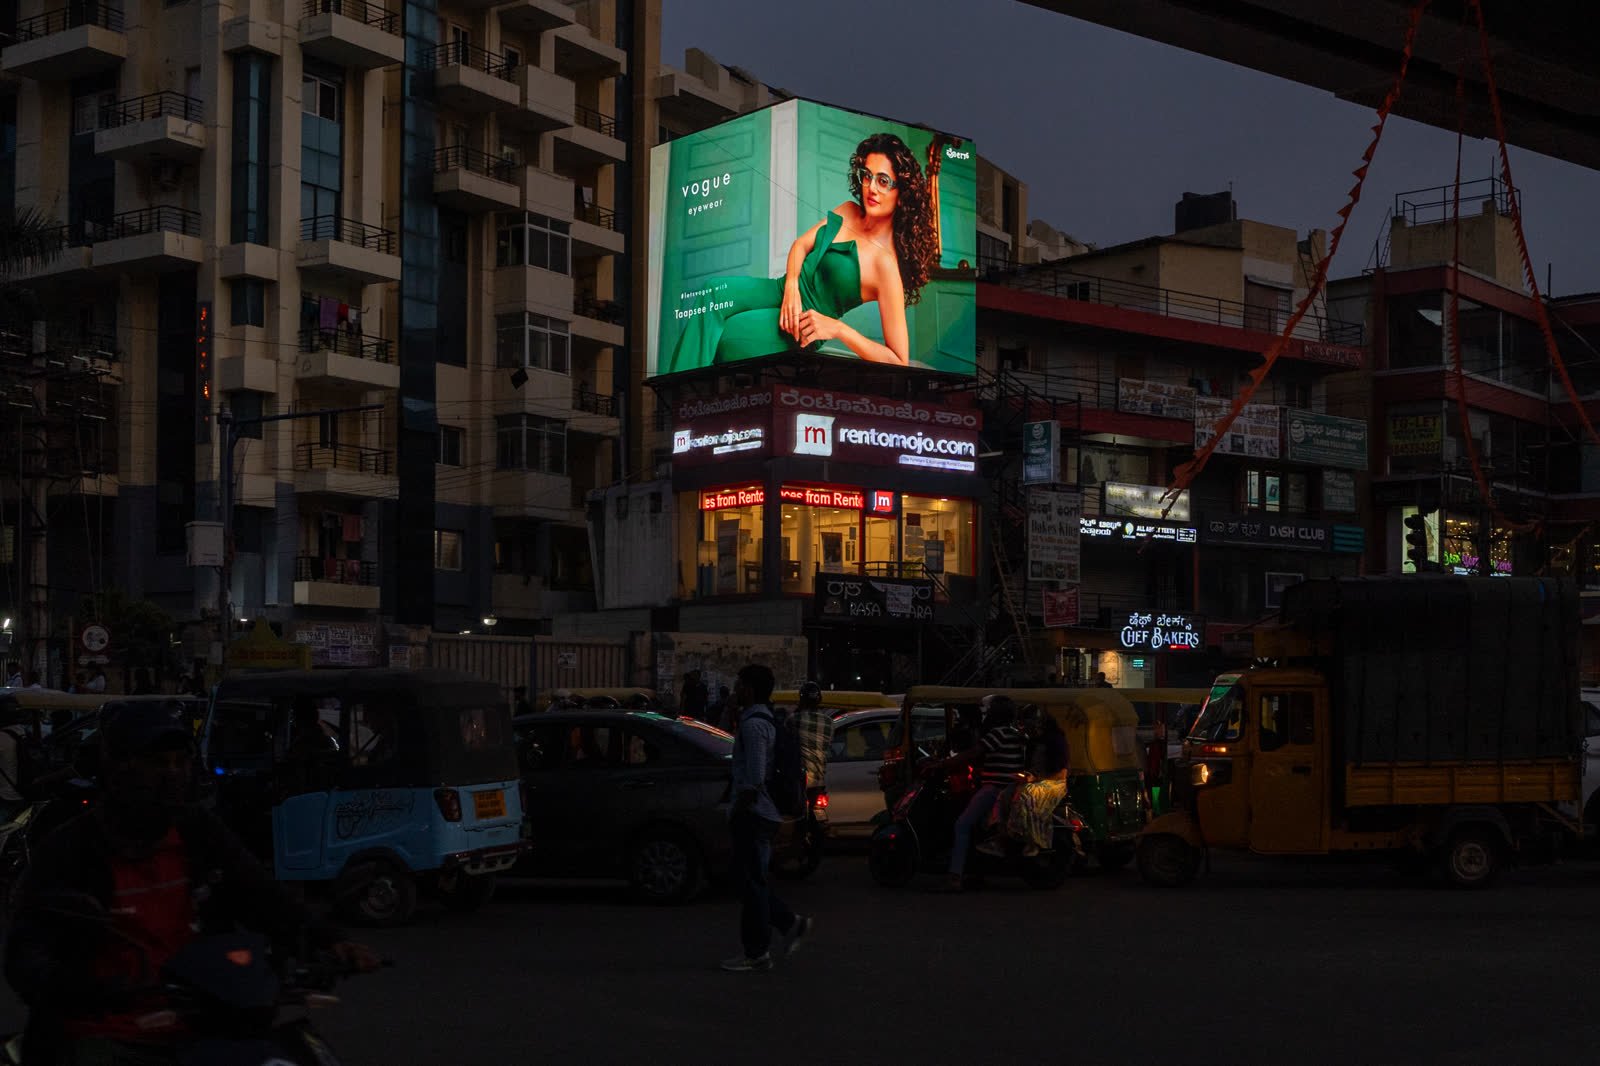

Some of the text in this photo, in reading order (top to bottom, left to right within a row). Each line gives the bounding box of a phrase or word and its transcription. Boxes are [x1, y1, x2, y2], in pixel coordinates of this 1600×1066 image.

[681, 172, 731, 198] vogue
[688, 198, 723, 216] eyewear
[674, 300, 735, 320] Taapsee Pannu
[839, 426, 977, 457] rentomojo.com
[717, 494, 737, 507] from
[806, 490, 831, 504] from
[1269, 525, 1325, 541] DASH CLUB
[848, 602, 881, 617] RASA
